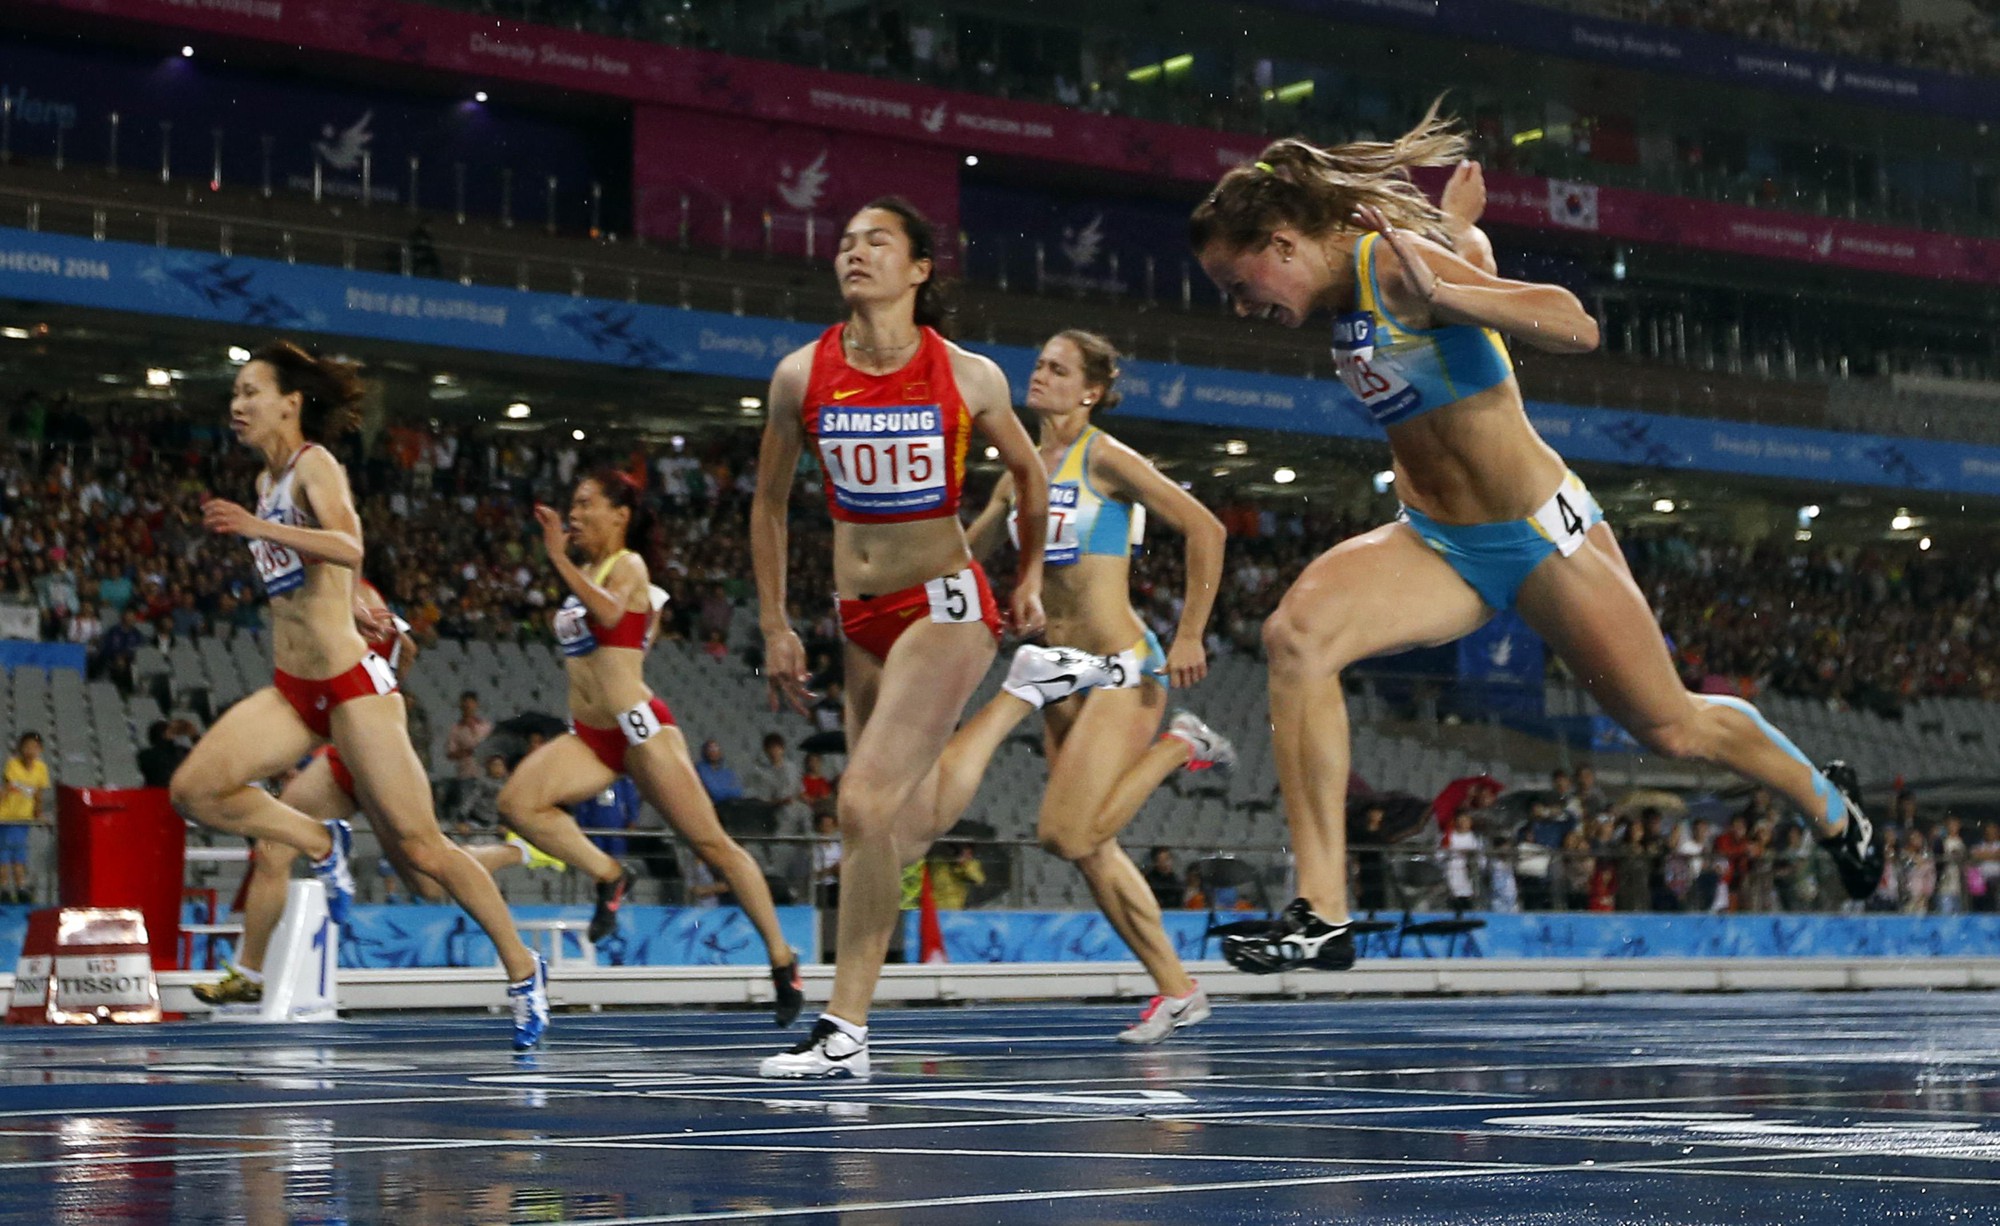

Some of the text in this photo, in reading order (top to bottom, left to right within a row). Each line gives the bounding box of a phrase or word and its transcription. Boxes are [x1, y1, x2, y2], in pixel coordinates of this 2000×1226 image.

[64, 257, 109, 281] 2014
[823, 411, 935, 432] SAMSUNG
[831, 443, 932, 485] 1015
[1556, 492, 1584, 536] 4
[944, 574, 967, 620] 5
[628, 709, 649, 738] 8
[312, 915, 328, 997] 1
[61, 977, 145, 995] TISSOT
